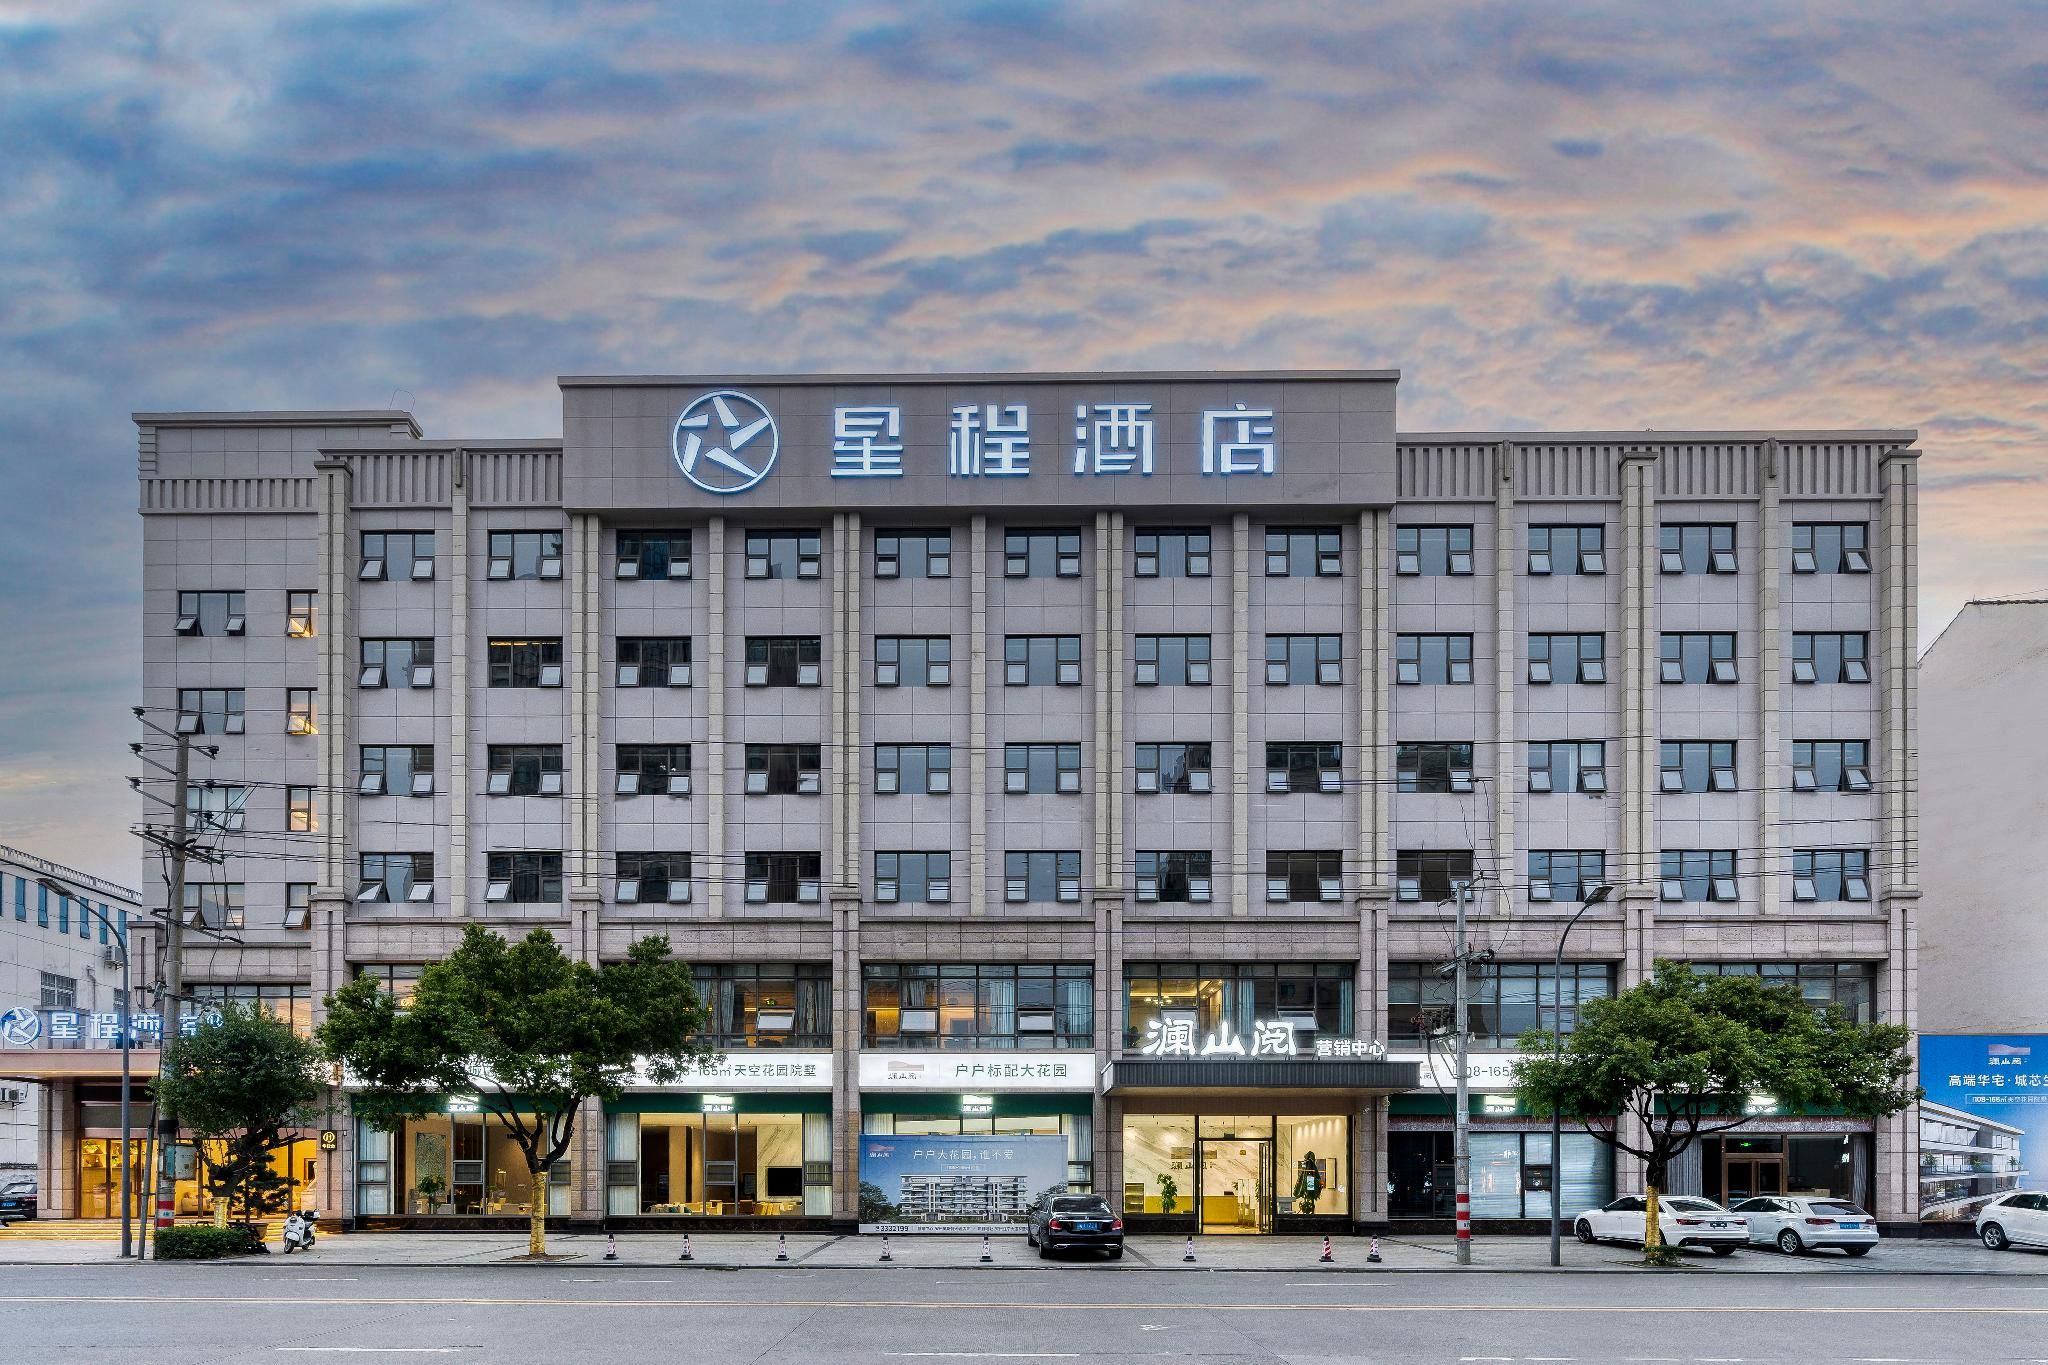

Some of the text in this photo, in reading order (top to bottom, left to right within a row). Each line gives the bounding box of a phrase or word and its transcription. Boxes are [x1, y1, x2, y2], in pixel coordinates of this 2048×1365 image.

[830, 402, 1274, 477] 星程酒店
[1143, 1017, 1386, 1057] 澜山阅 营销中心
[955, 1063, 1067, 1078] 户户标配大花园
